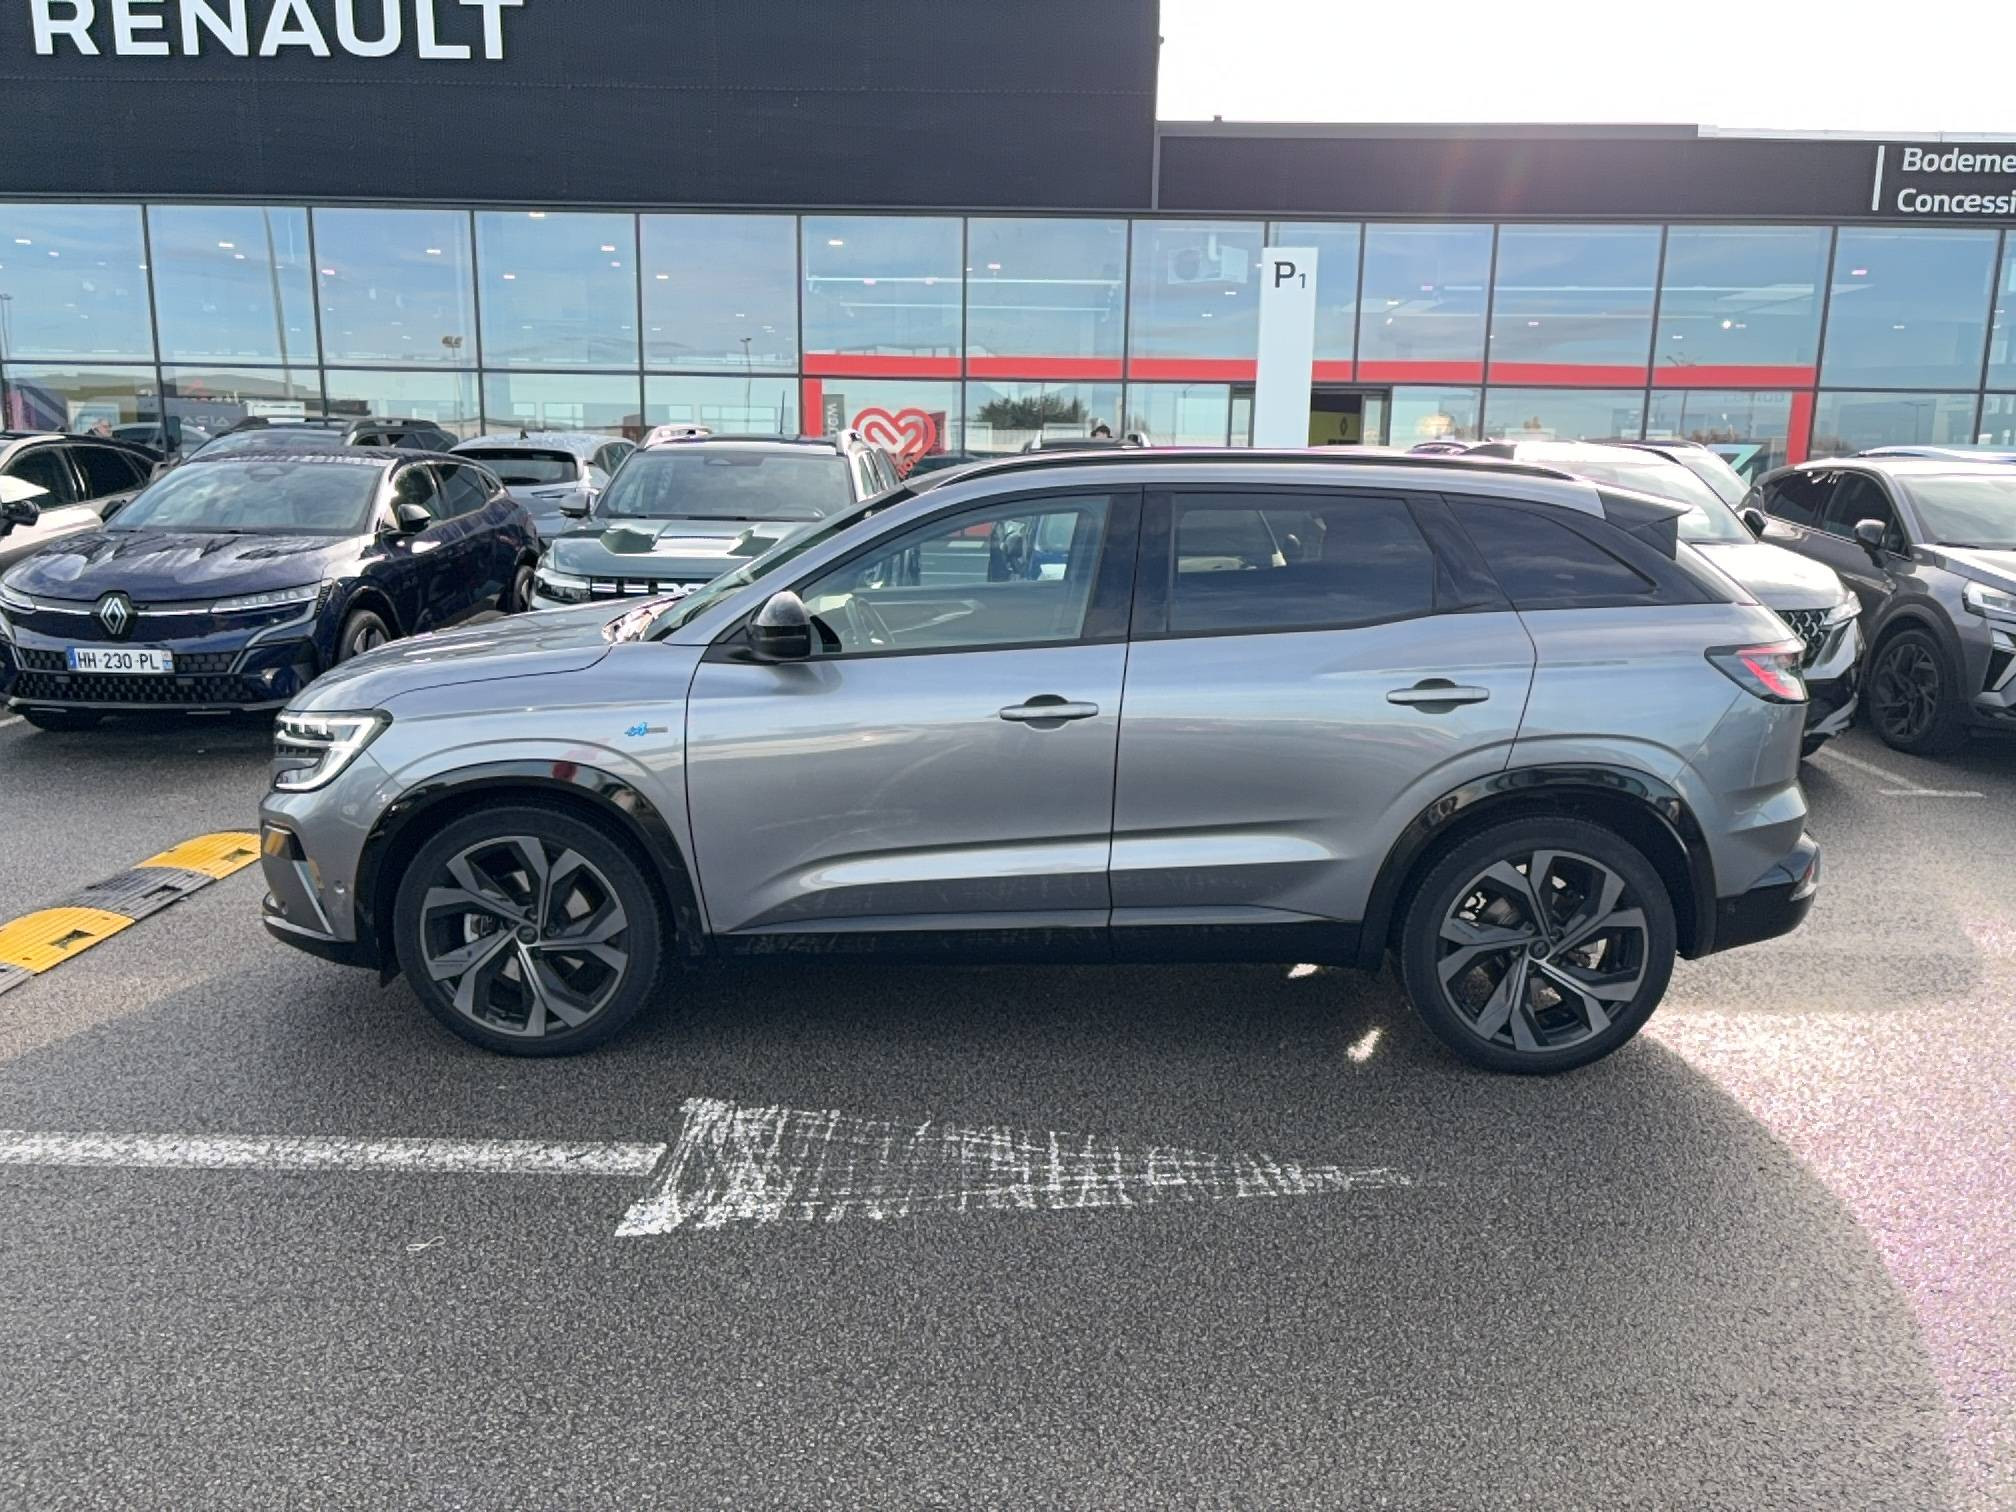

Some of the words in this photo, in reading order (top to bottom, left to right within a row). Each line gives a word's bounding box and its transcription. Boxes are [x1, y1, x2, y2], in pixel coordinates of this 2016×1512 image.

[29, 0, 524, 60] RENAULT
[1902, 147, 2016, 173] Bodeme
[1897, 188, 2016, 214] Concessi
